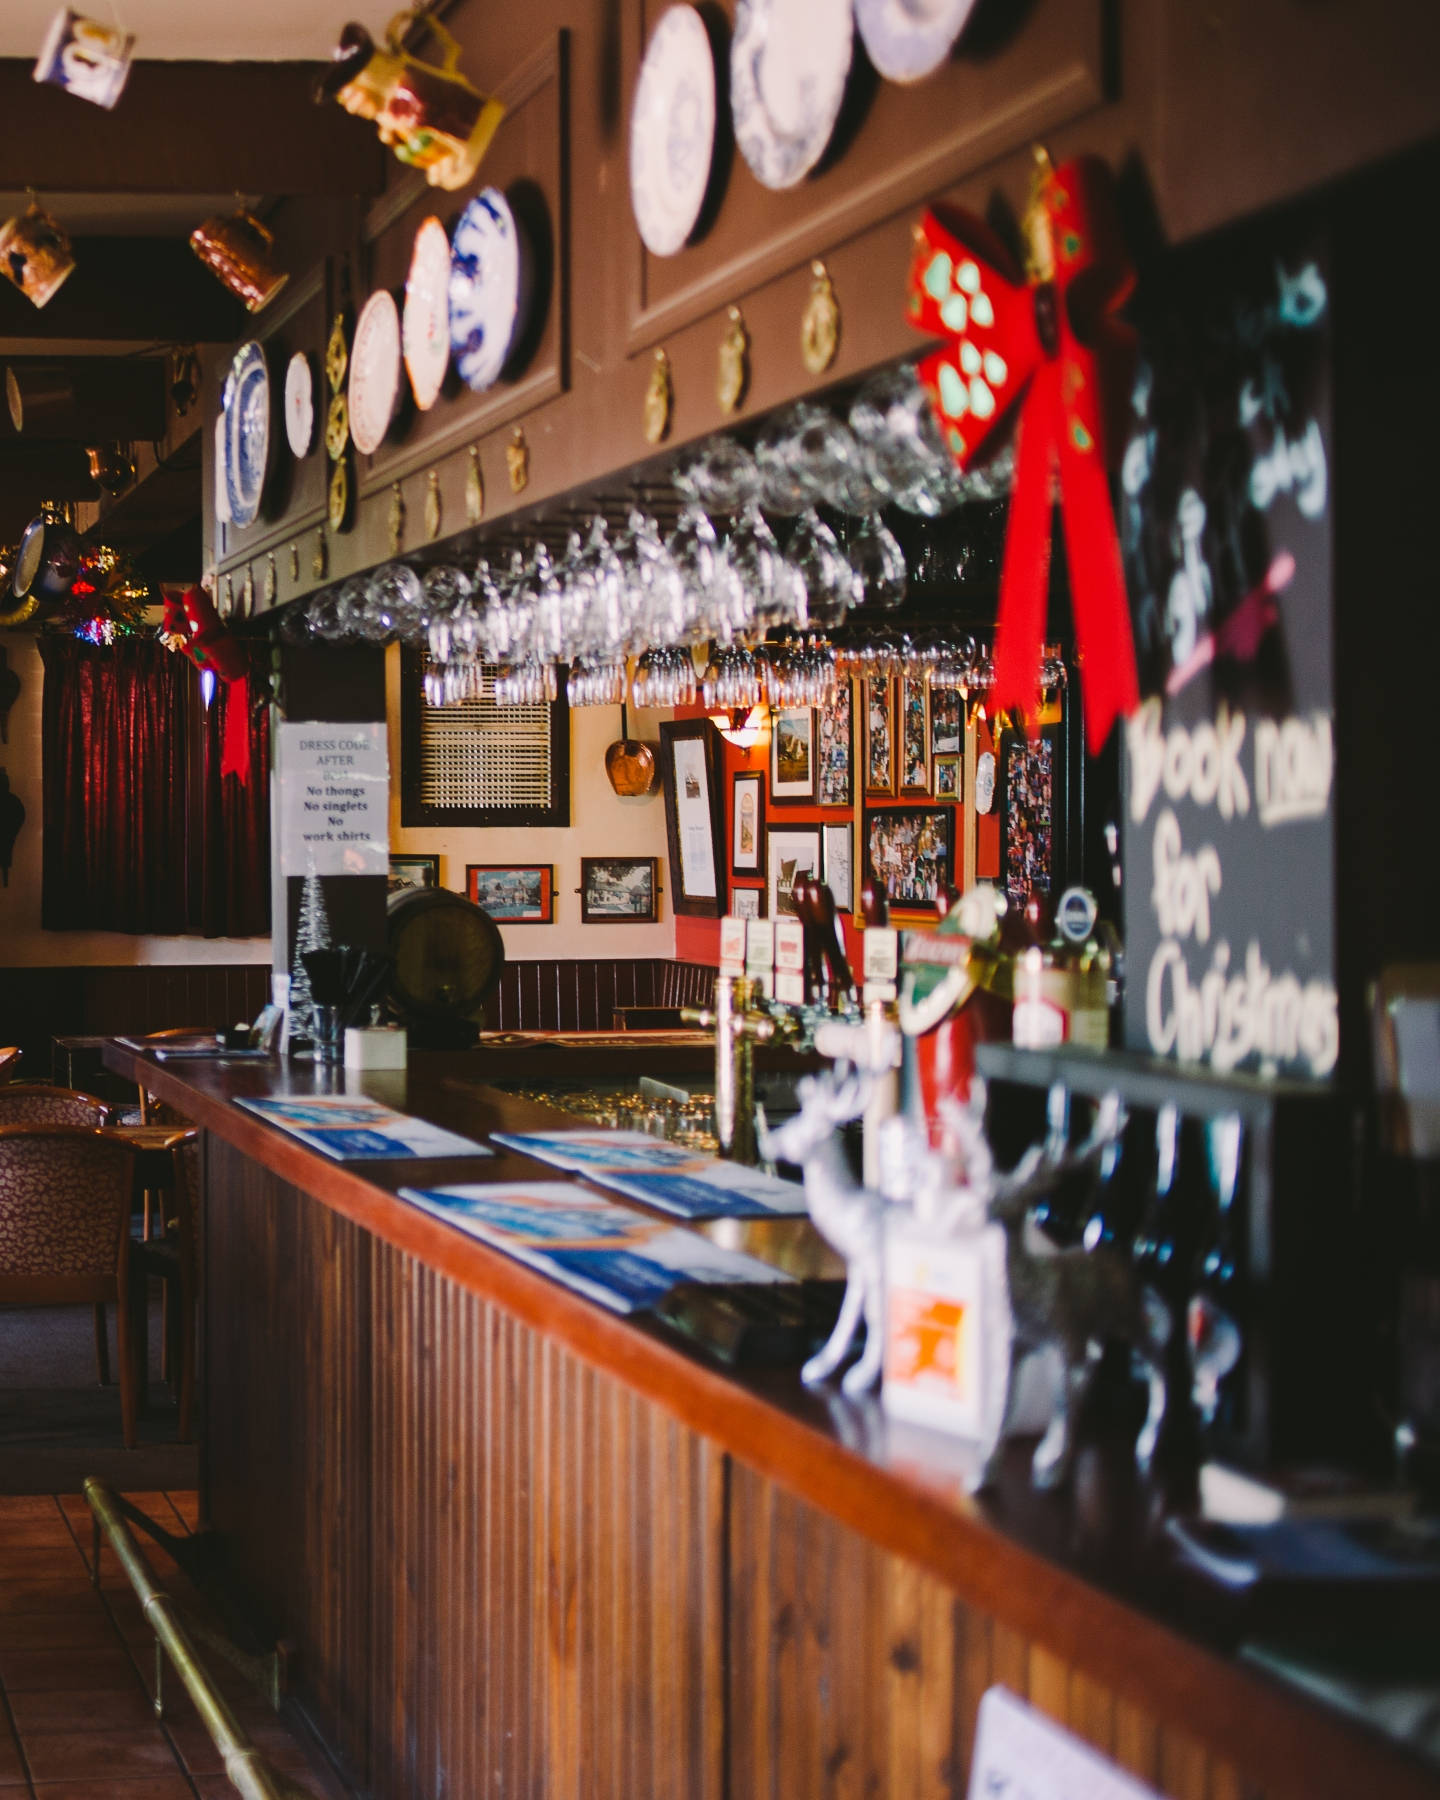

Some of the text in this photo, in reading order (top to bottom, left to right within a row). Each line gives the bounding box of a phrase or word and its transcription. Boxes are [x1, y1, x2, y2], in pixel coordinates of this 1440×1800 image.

[299, 740, 370, 751] DRESS CODE
[317, 755, 355, 766] AFTER
[307, 786, 366, 799] No thongs
[304, 801, 368, 814] No singlets
[328, 816, 344, 827] No
[303, 831, 371, 842] work shirts
[1151, 807, 1222, 946] for
[1147, 938, 1340, 1078] Christmas
